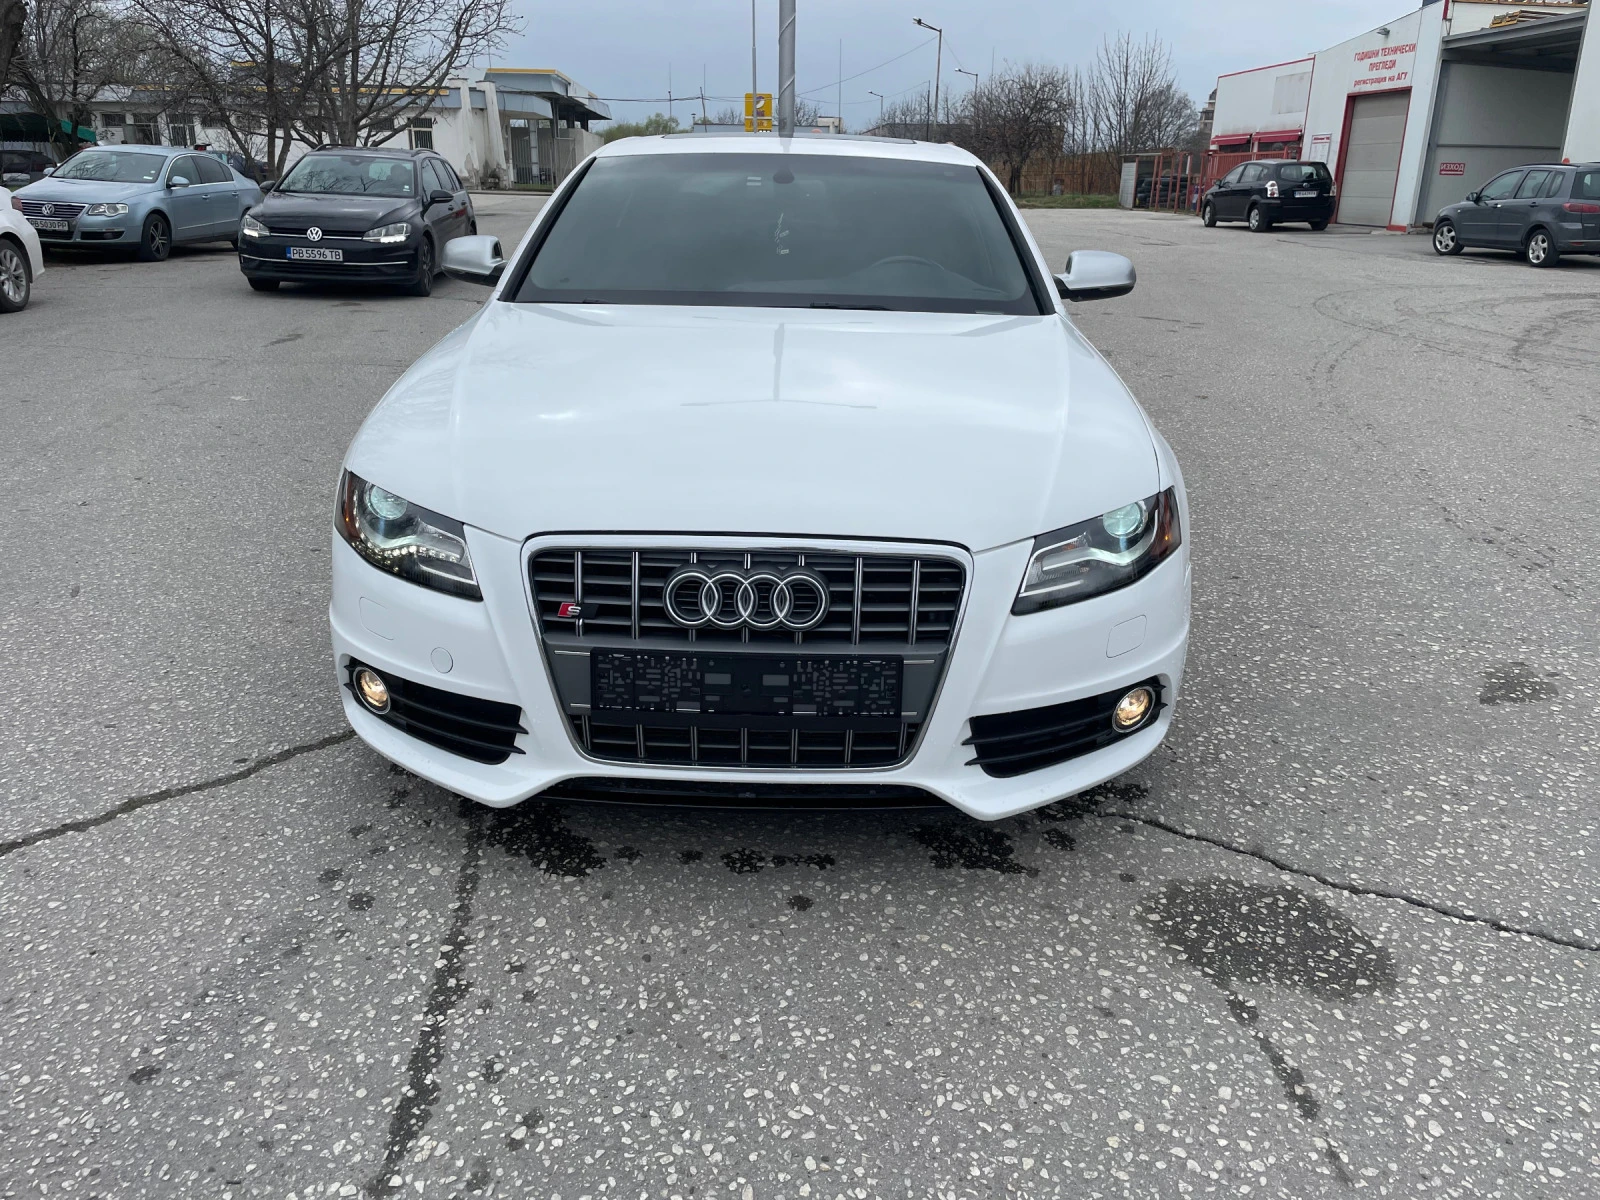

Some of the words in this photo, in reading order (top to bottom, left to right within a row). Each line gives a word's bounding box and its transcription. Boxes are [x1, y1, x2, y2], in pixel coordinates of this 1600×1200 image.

[1381, 43, 1416, 56] ТЕХНИЧЕСКИ
[1369, 60, 1396, 71] ПРЕГЛЕДИ
[1440, 163, 1464, 172] ИЗХОД
[292, 248, 304, 258] PB
[306, 249, 327, 258] 5596
[329, 250, 341, 260] TB
